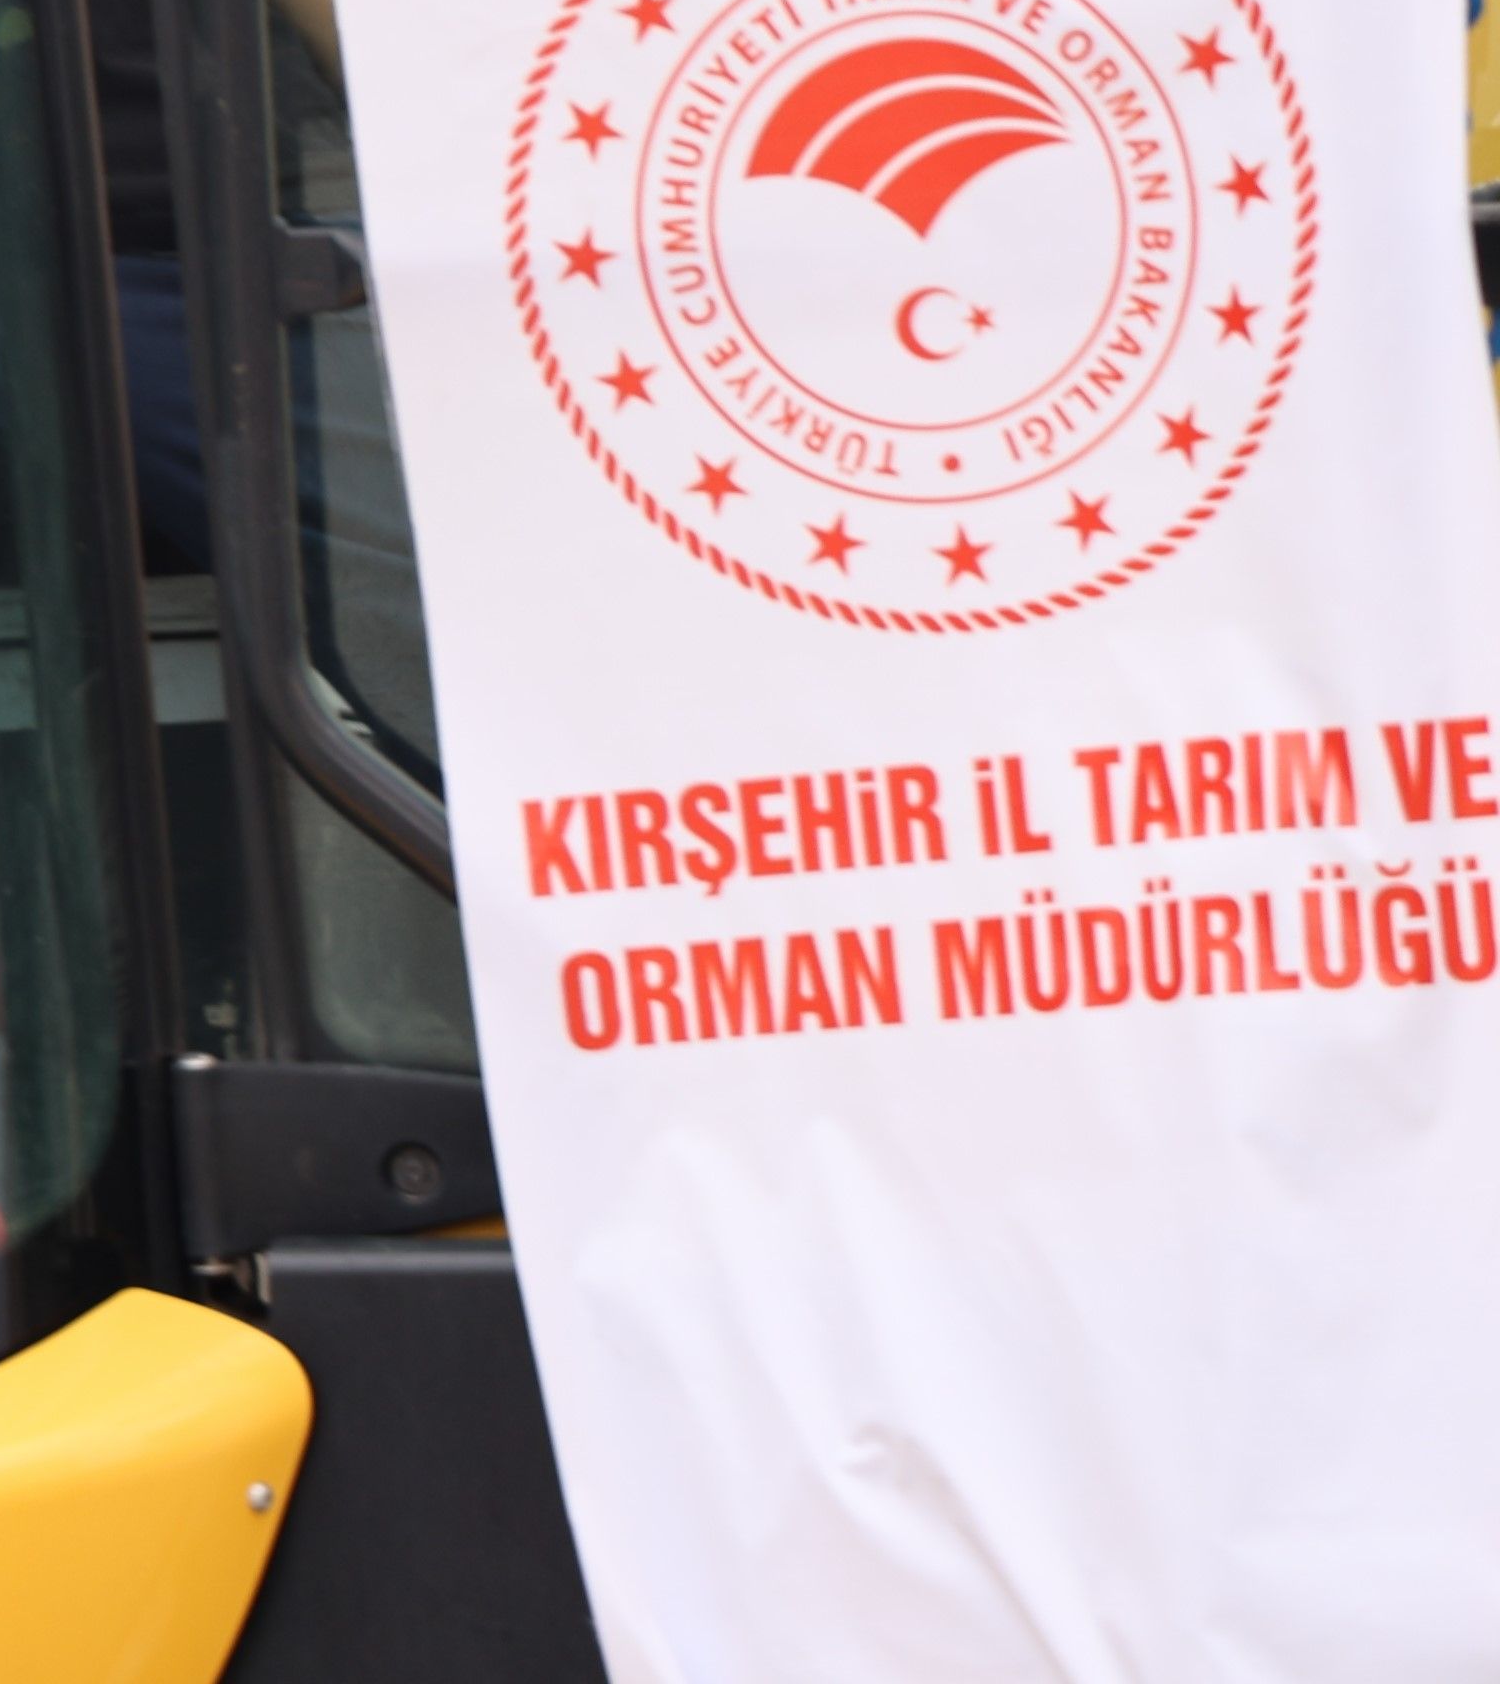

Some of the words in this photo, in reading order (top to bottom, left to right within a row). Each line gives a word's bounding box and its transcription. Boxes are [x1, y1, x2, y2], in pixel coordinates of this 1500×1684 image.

[1057, 28, 1173, 205] ORMAN
[704, 336, 900, 479] TÜRKİYE
[1001, 225, 1178, 462] BAKANLIĞI
[1072, 724, 1361, 850] TARIM
[1379, 713, 1500, 826] VE
[559, 923, 907, 1054] ORMAN
[930, 854, 1499, 1024] MÜDÜRLÜĞÜ
